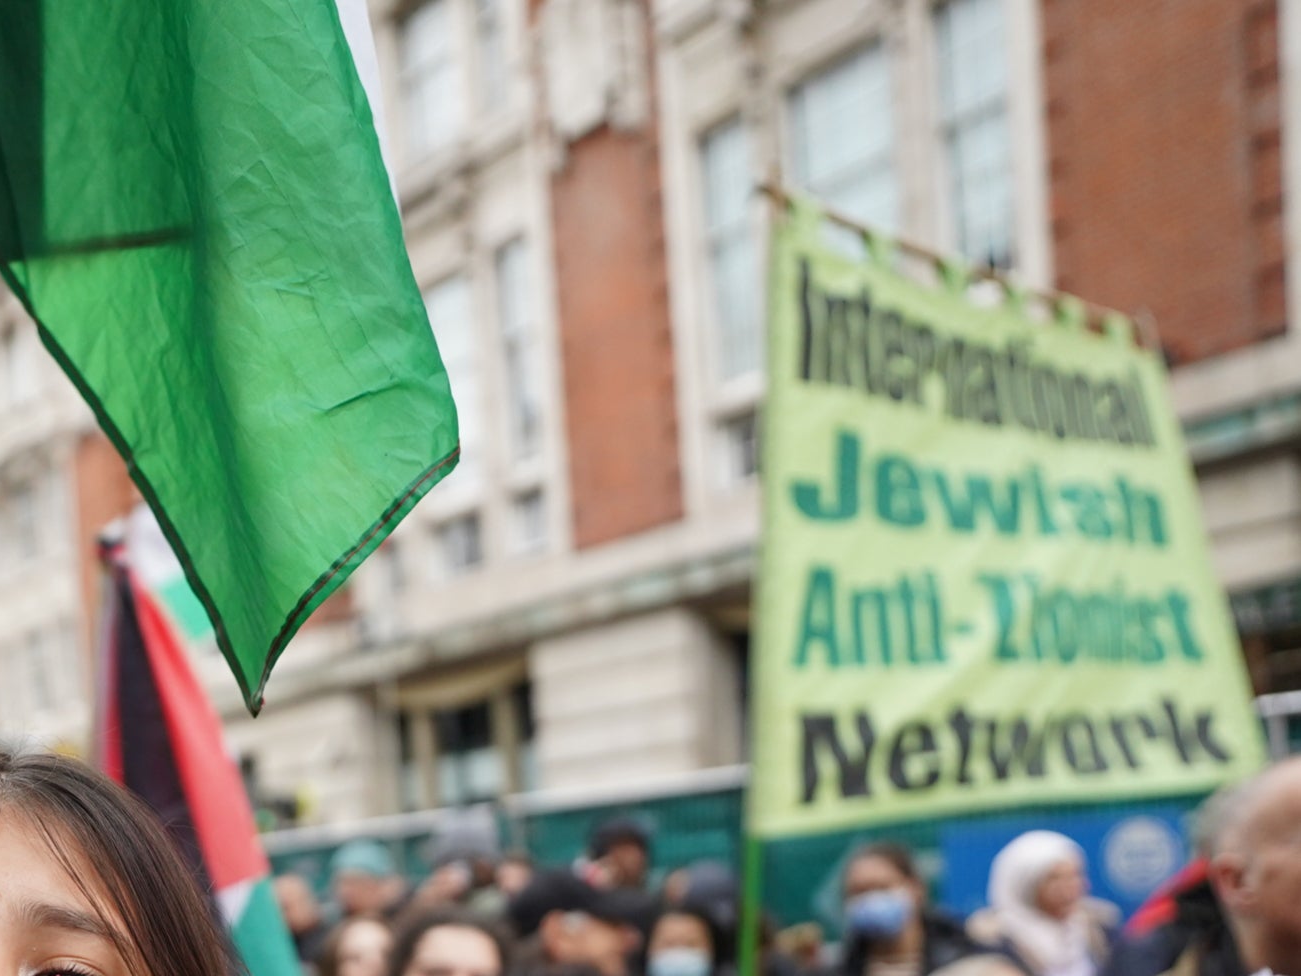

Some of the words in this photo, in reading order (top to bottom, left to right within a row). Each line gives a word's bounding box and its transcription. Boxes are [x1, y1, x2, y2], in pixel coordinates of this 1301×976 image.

[798, 257, 1155, 447] International
[790, 429, 1166, 547] Jewish
[792, 566, 1202, 667] Anti-Zionist
[799, 698, 1232, 804] Network
